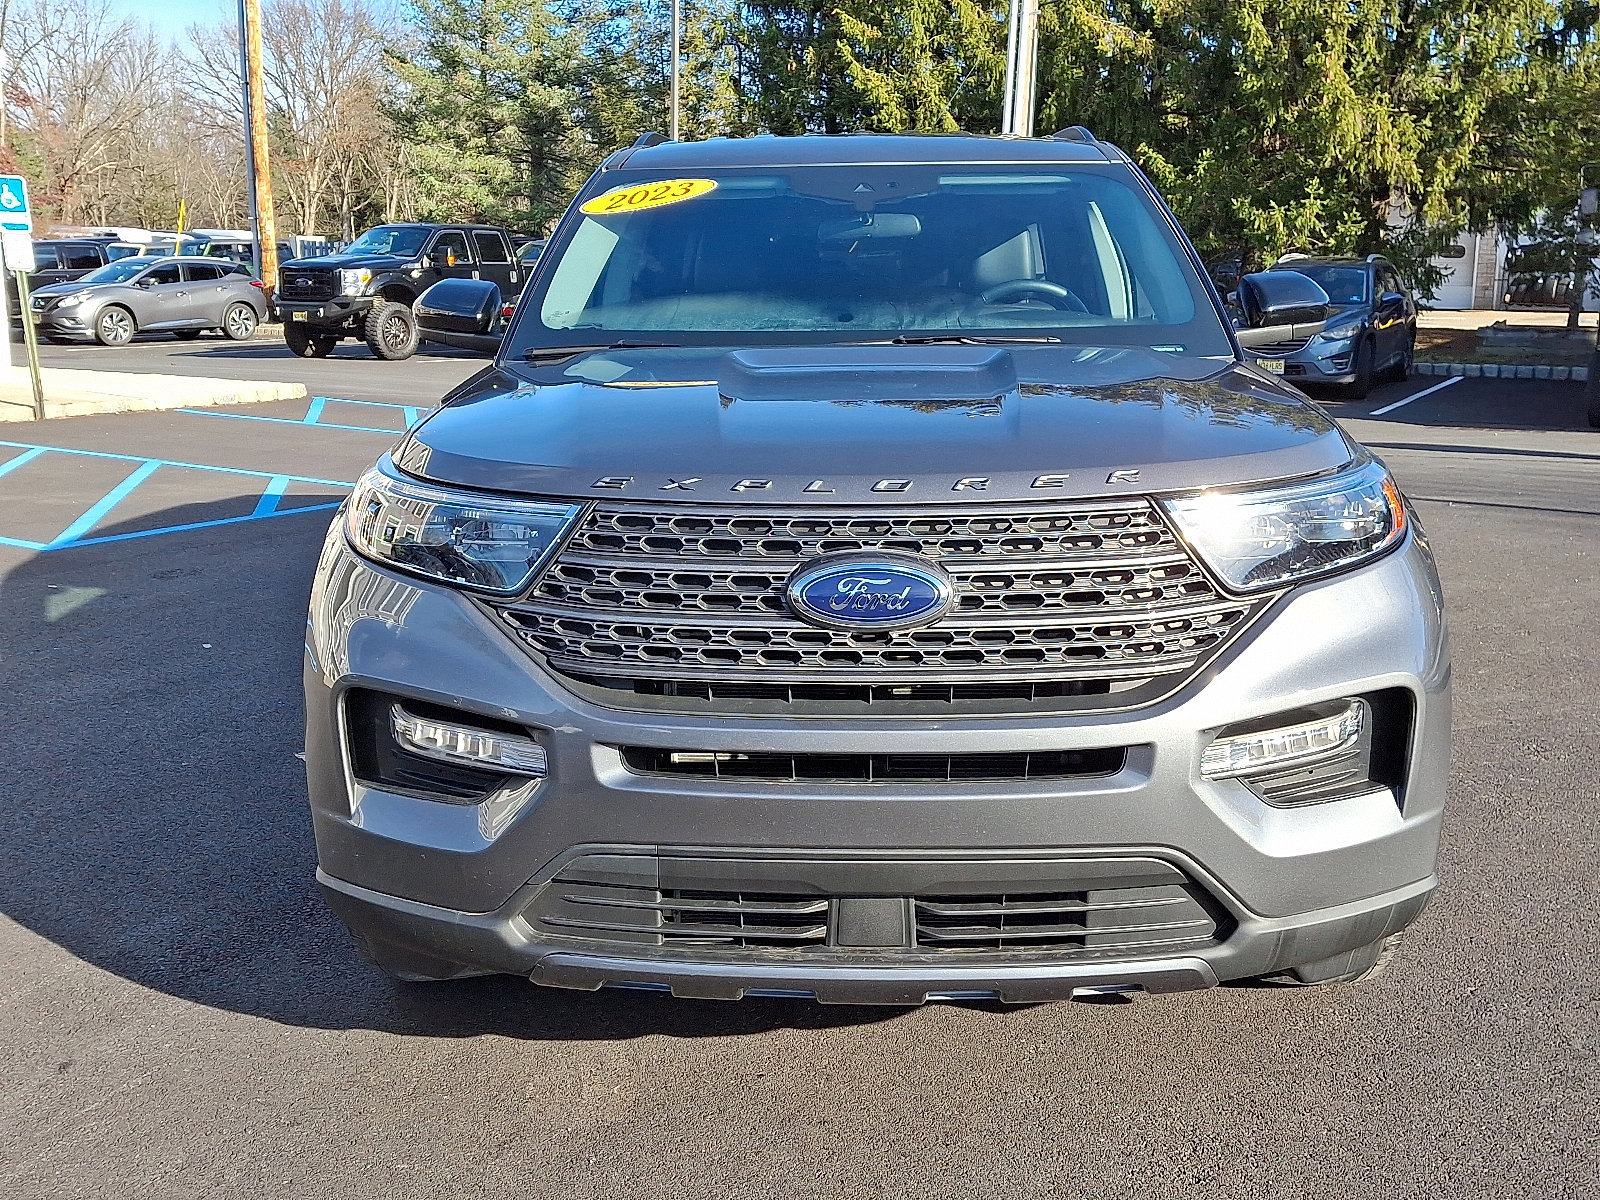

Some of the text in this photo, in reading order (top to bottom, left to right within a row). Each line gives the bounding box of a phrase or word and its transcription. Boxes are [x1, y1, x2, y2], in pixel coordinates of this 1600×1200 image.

[604, 182, 694, 211] 2023
[590, 469, 1142, 494] EXPLORER
[829, 577, 911, 611] Ford
